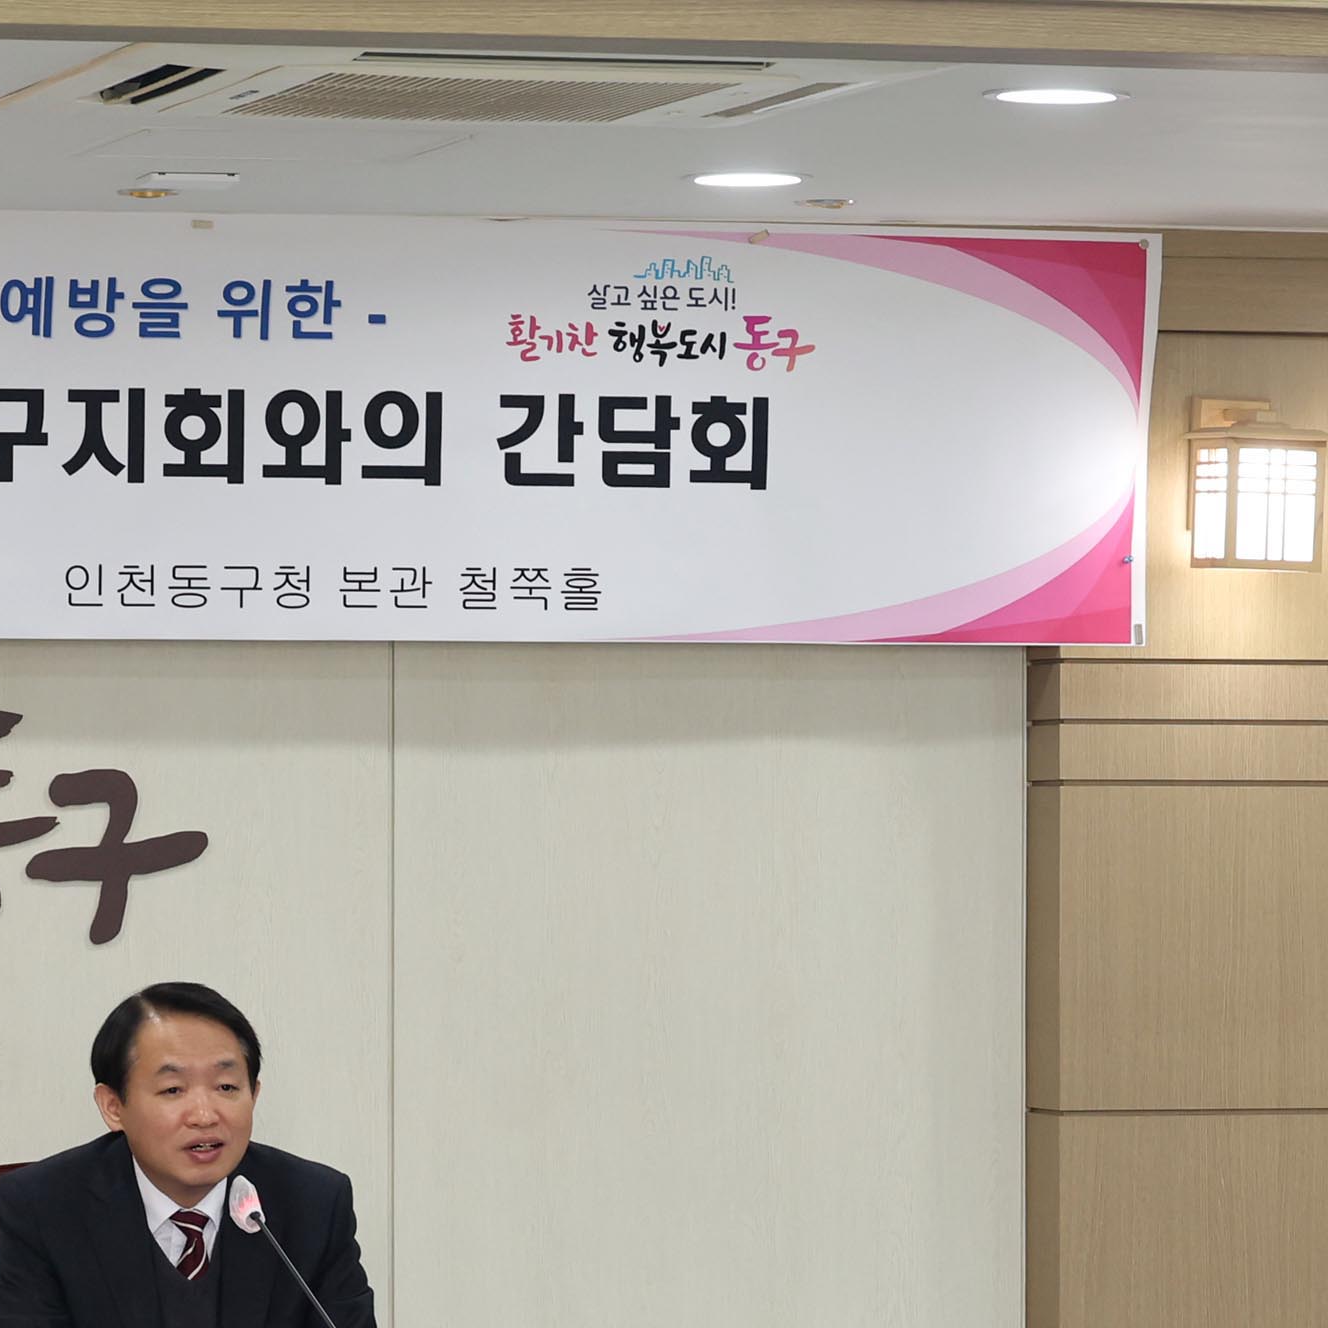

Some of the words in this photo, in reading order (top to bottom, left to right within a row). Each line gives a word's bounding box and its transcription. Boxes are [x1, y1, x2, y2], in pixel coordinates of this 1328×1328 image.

[0, 275, 189, 339] 예방을
[217, 278, 342, 341] 위한
[587, 283, 632, 311] 살고
[636, 284, 681, 312] 싶은
[686, 285, 736, 312] 도시!
[505, 313, 599, 363] 활기찬
[607, 319, 728, 368] 행복도시
[732, 315, 816, 373] 동구
[496, 393, 770, 491] 간담회
[64, 563, 313, 610] 인천동구청
[338, 565, 433, 610] 본관
[458, 566, 603, 612] 철쭉홀
